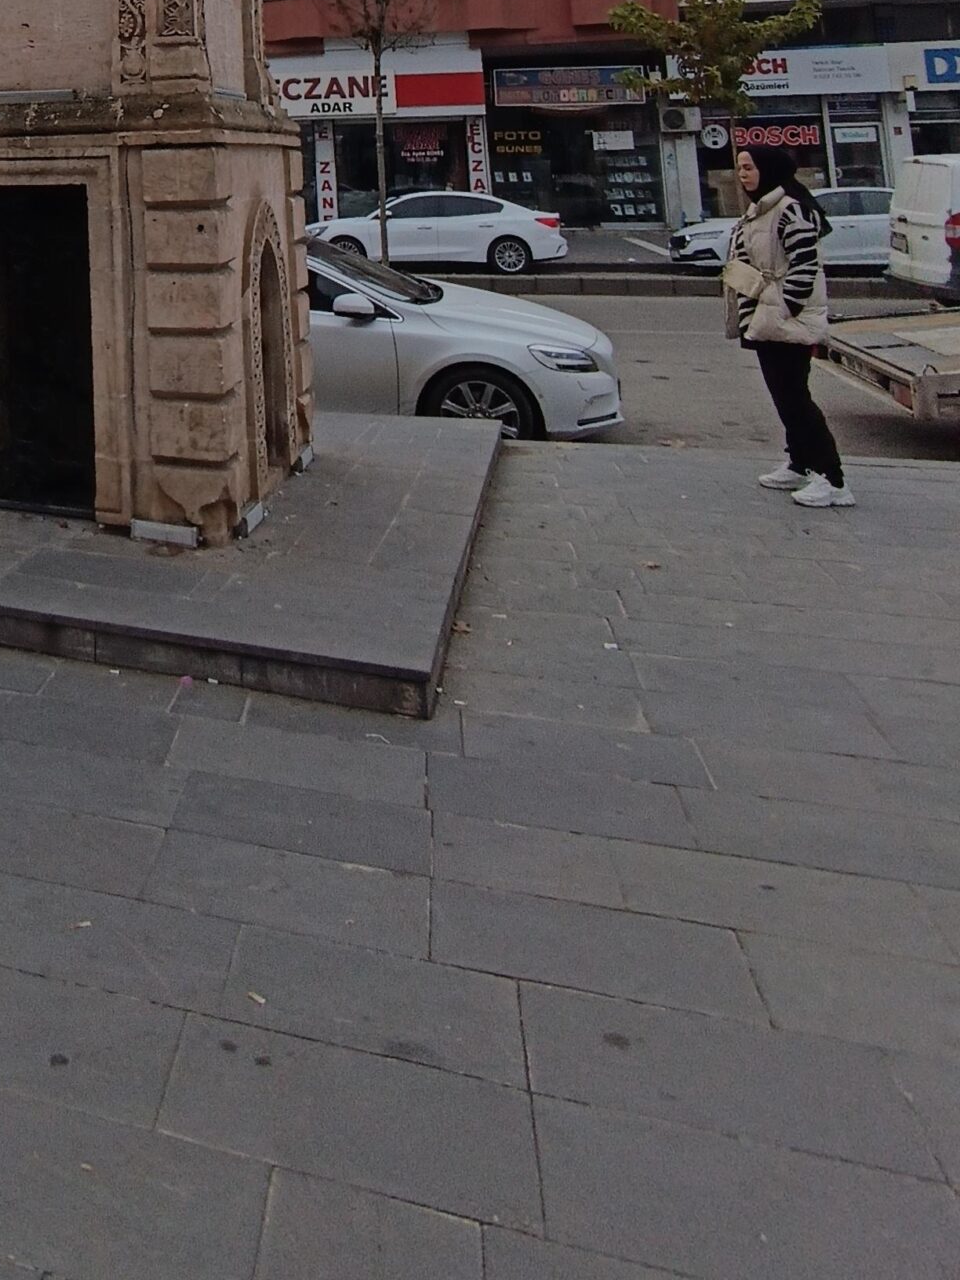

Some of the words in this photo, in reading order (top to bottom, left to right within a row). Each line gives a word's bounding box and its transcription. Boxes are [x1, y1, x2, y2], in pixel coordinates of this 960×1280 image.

[275, 75, 388, 101] CZANE
[310, 102, 353, 113] ADAR
[494, 131, 541, 141] FOTO
[735, 125, 820, 146] BOSCH
